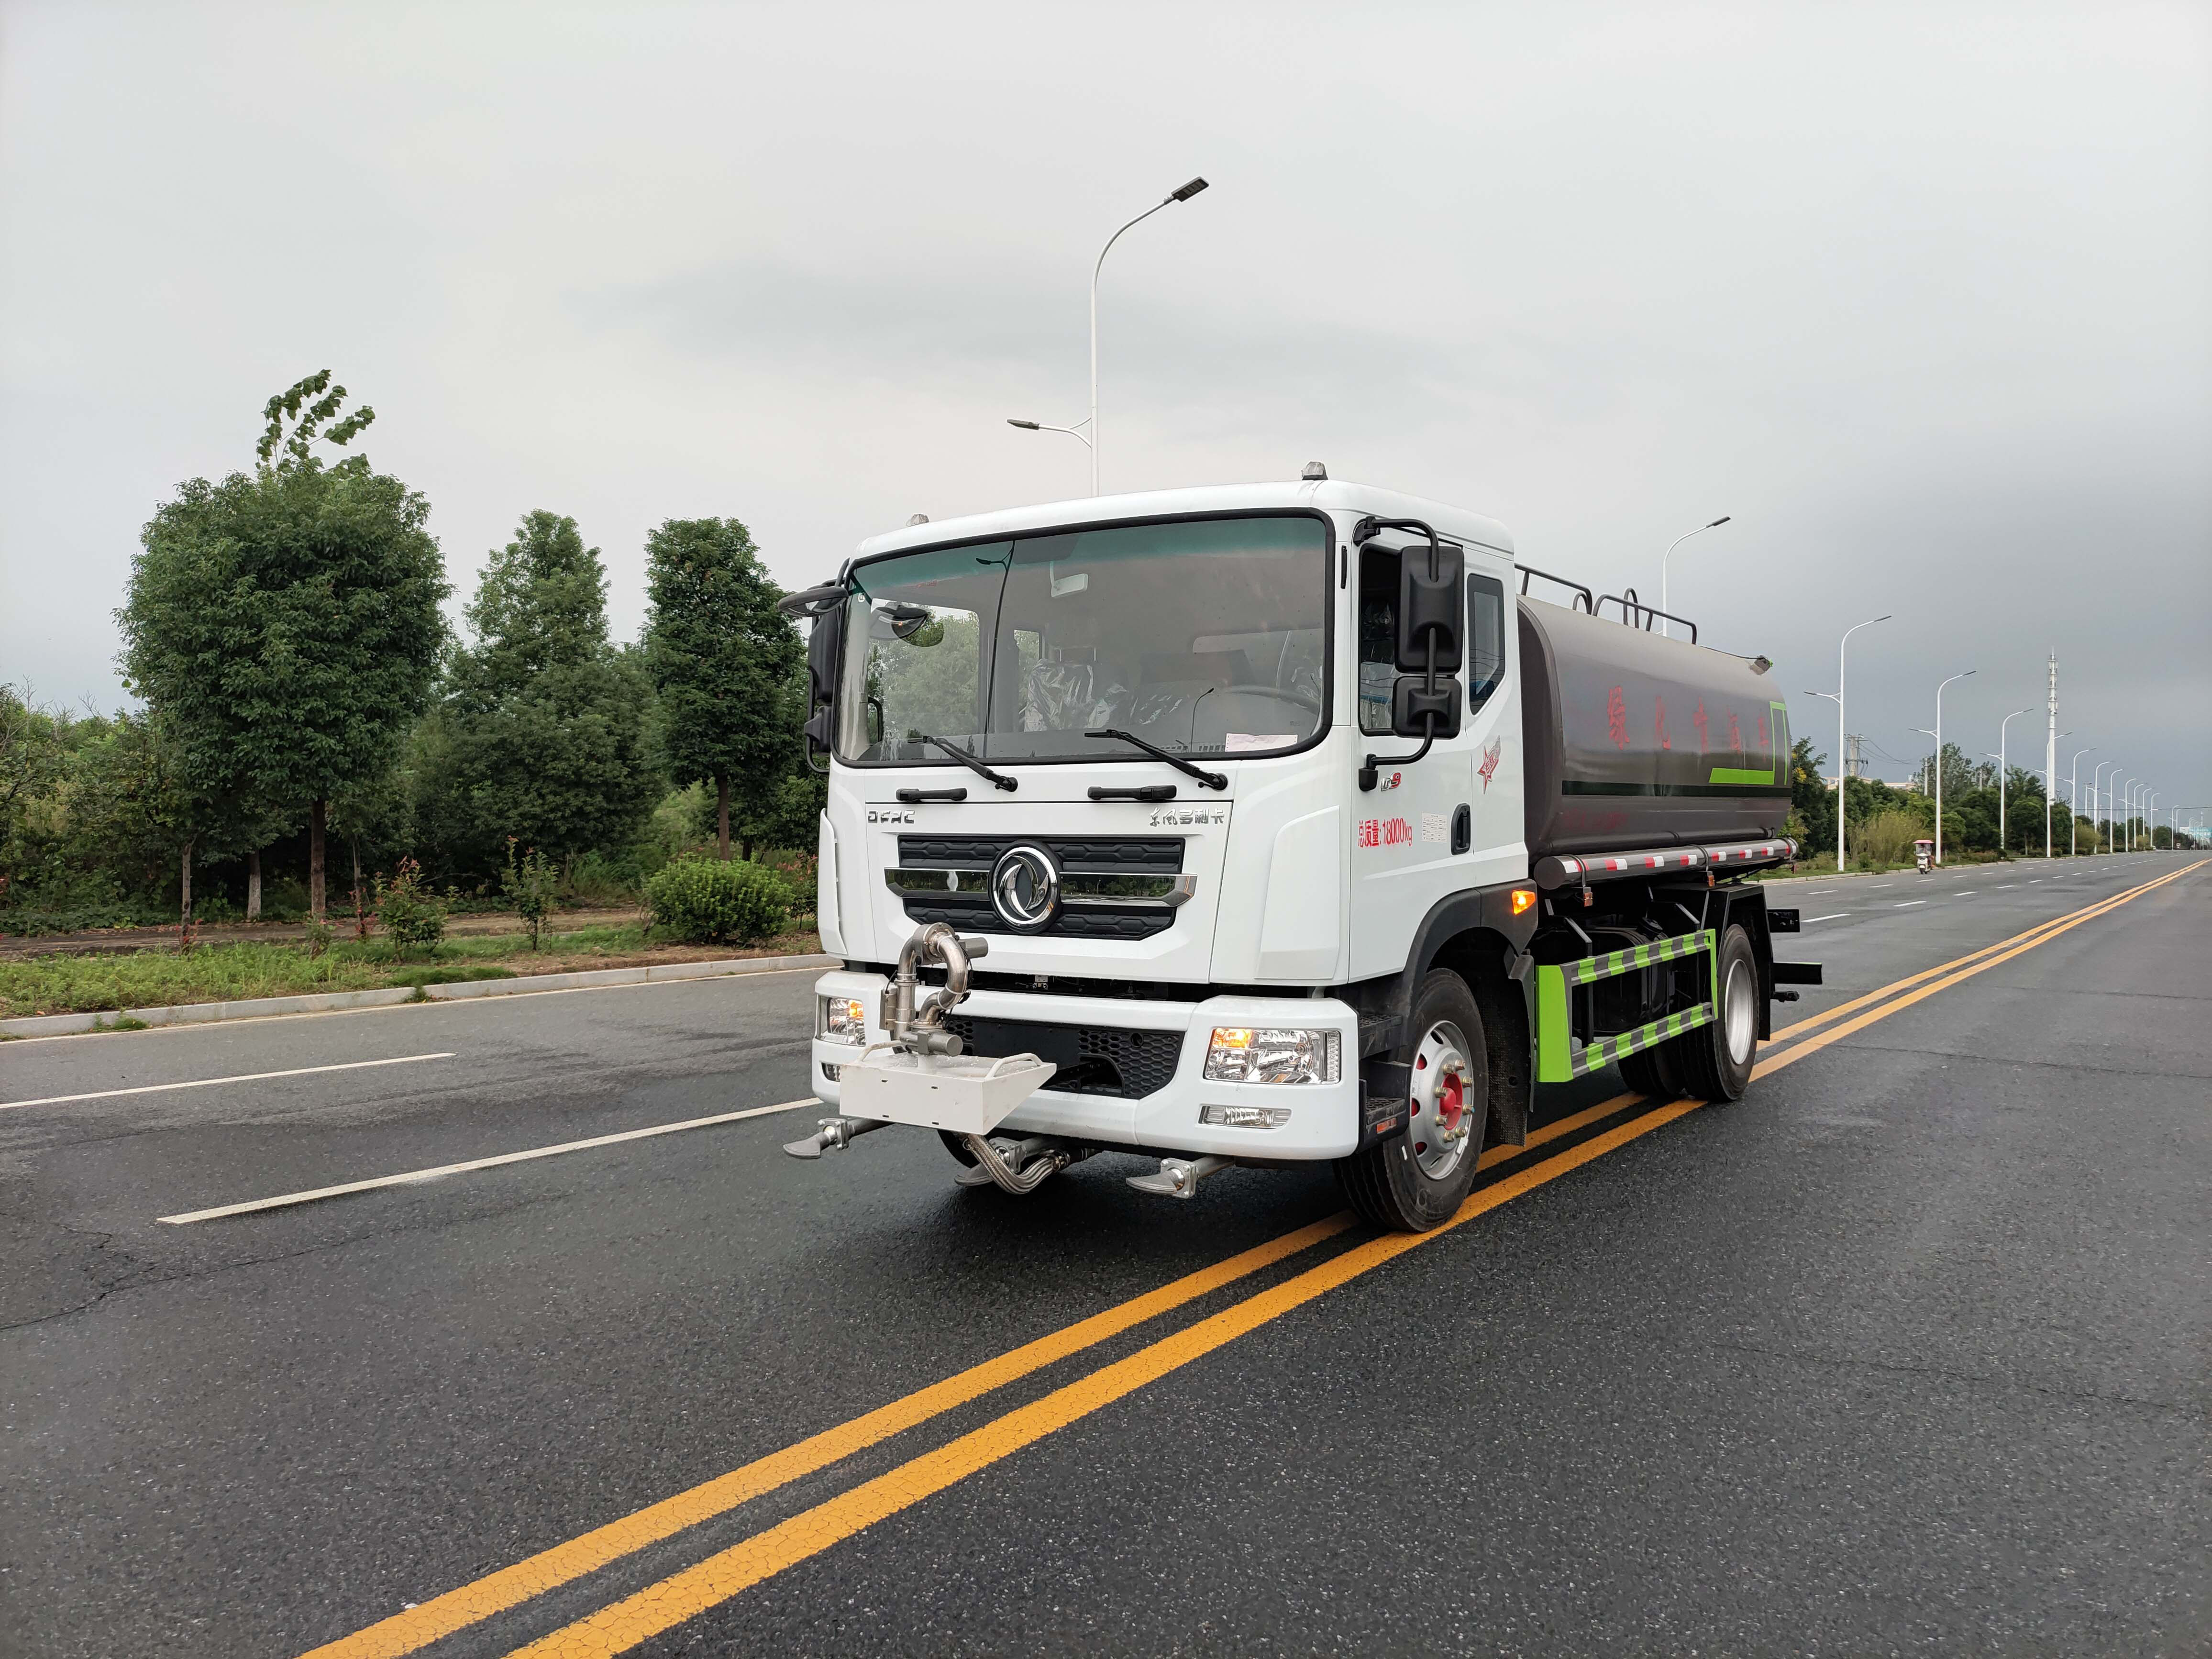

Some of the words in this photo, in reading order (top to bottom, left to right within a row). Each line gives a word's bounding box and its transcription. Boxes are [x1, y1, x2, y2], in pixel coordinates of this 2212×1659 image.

[868, 810, 915, 824] DFAC
[1149, 807, 1225, 827] 东风多利卡
